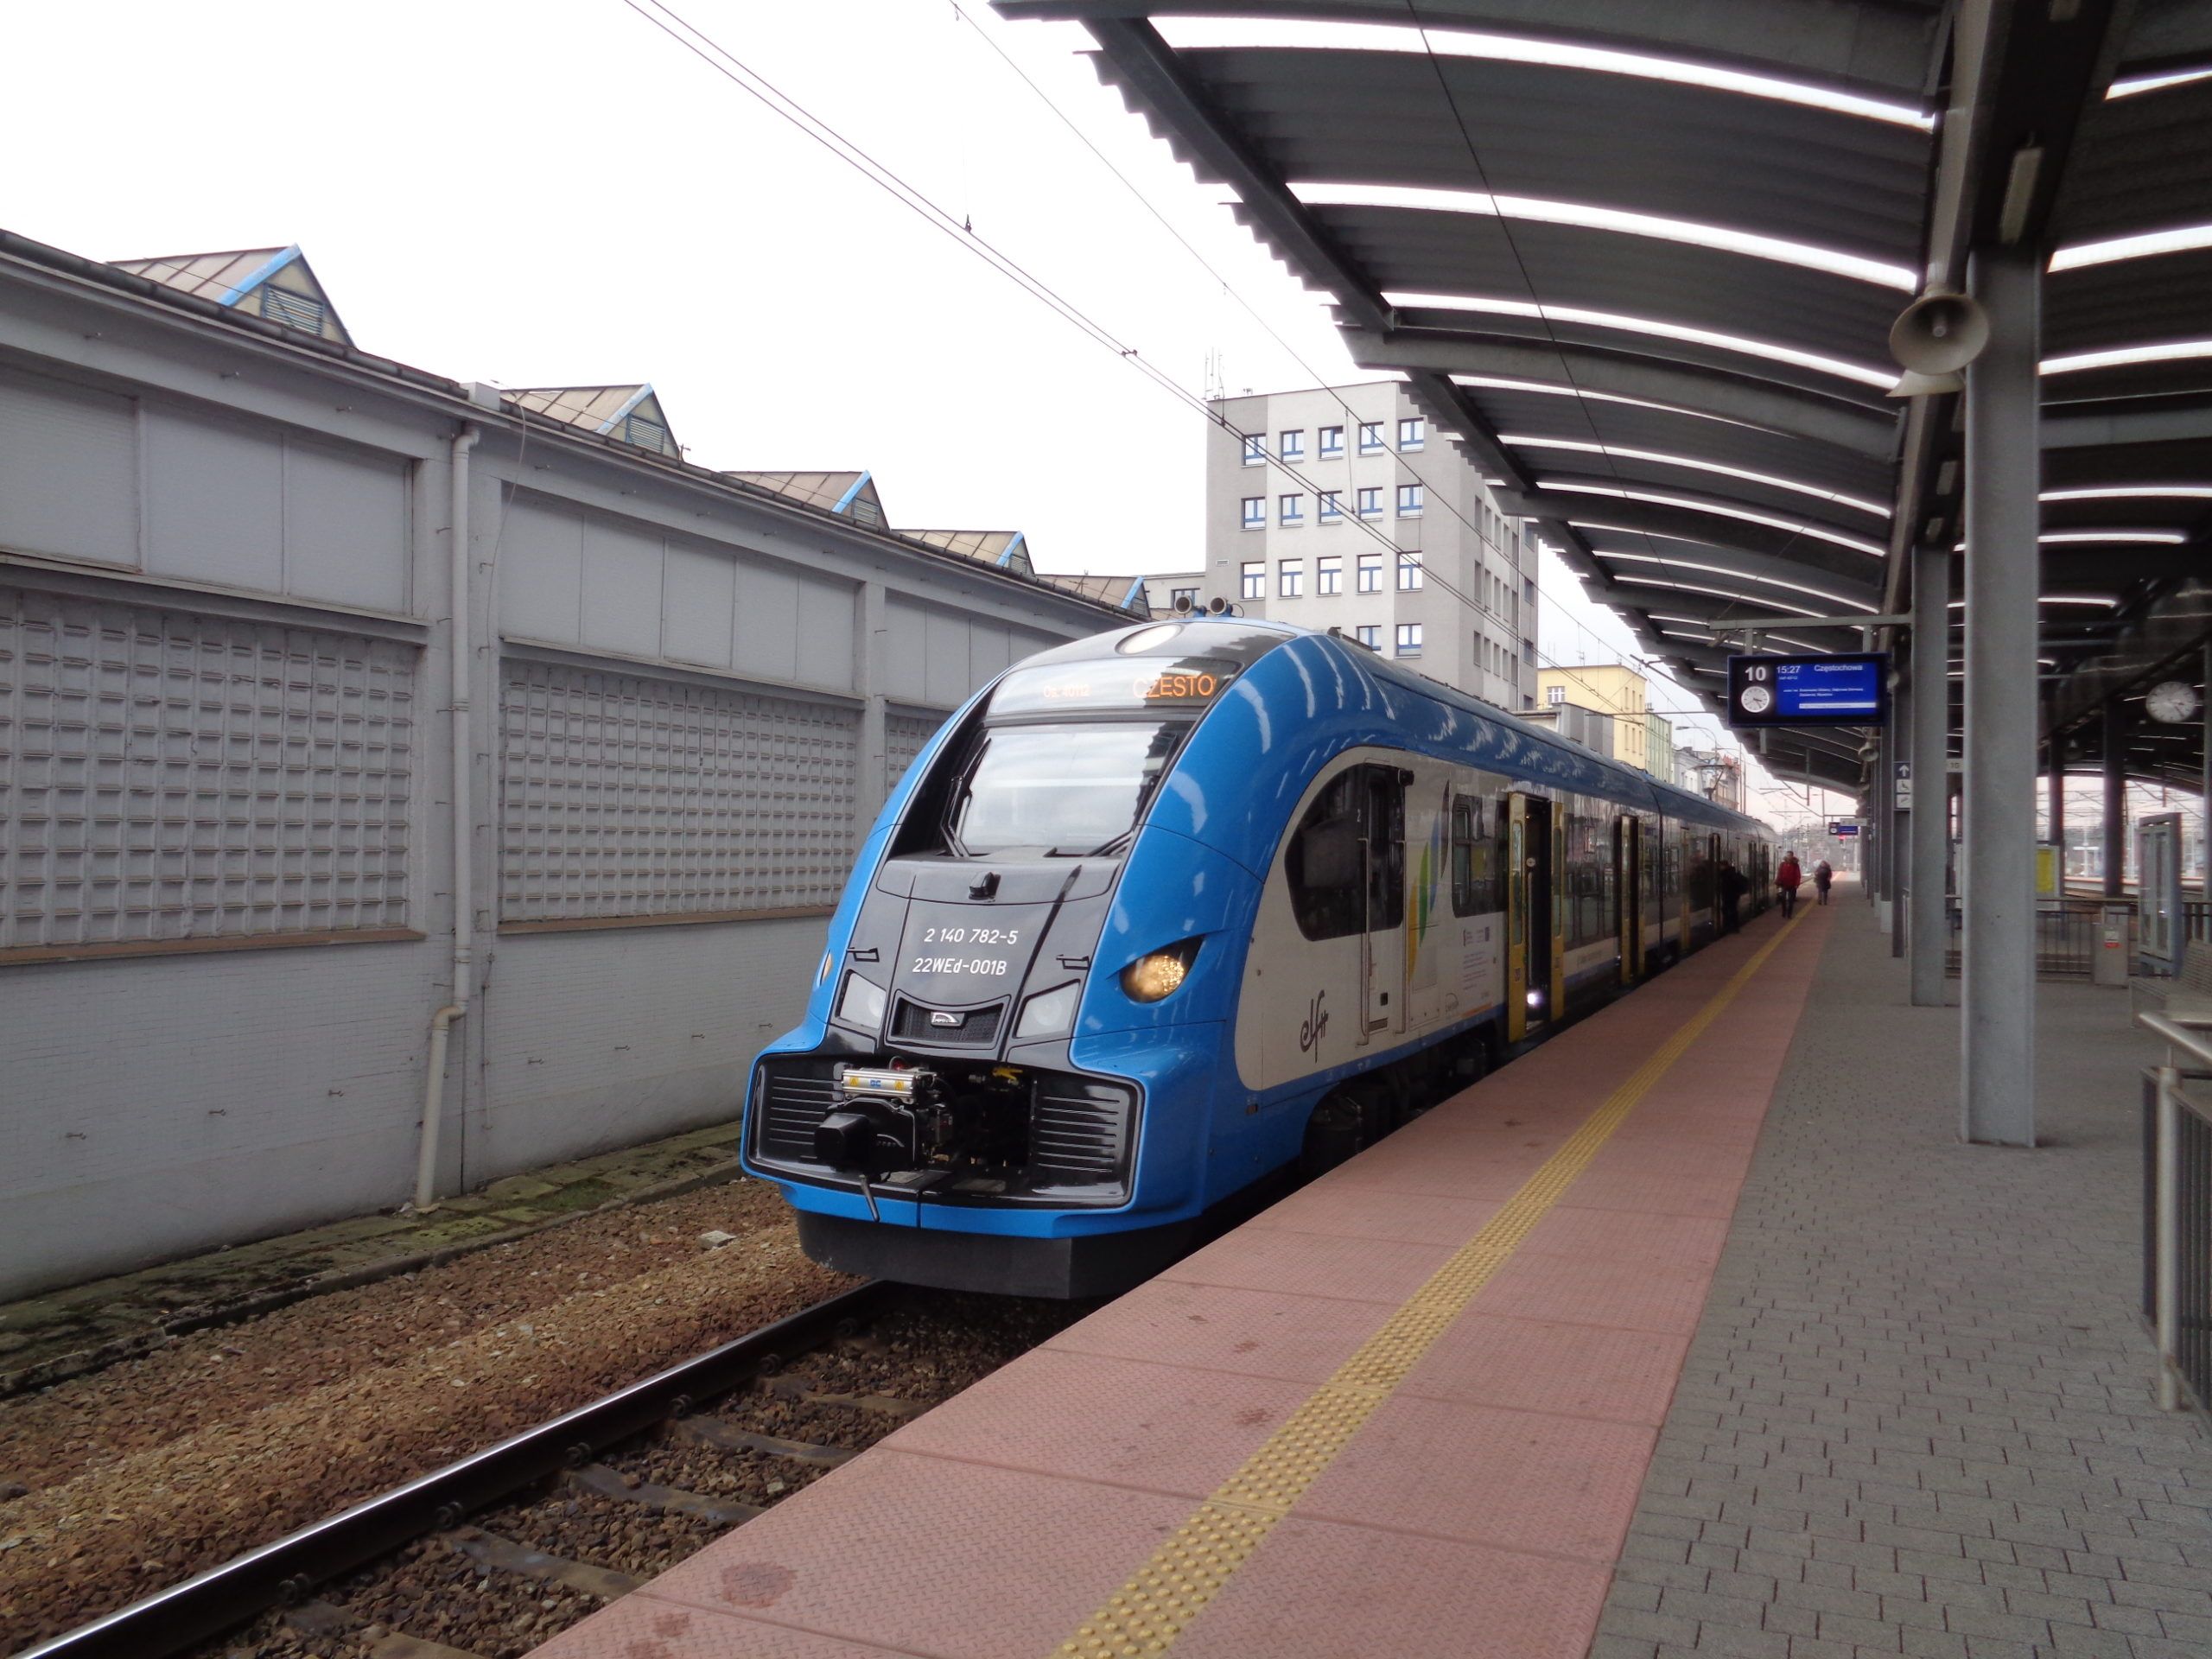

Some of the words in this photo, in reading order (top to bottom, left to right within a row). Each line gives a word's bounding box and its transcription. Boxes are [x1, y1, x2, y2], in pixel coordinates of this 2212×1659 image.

[1745, 665, 1766, 681] 10
[1777, 665, 1801, 674] 15:27
[924, 928, 936, 943] 2
[939, 928, 965, 943] 140
[969, 929, 1019, 944] 782-5
[912, 957, 1007, 976] 22WEd-001B
